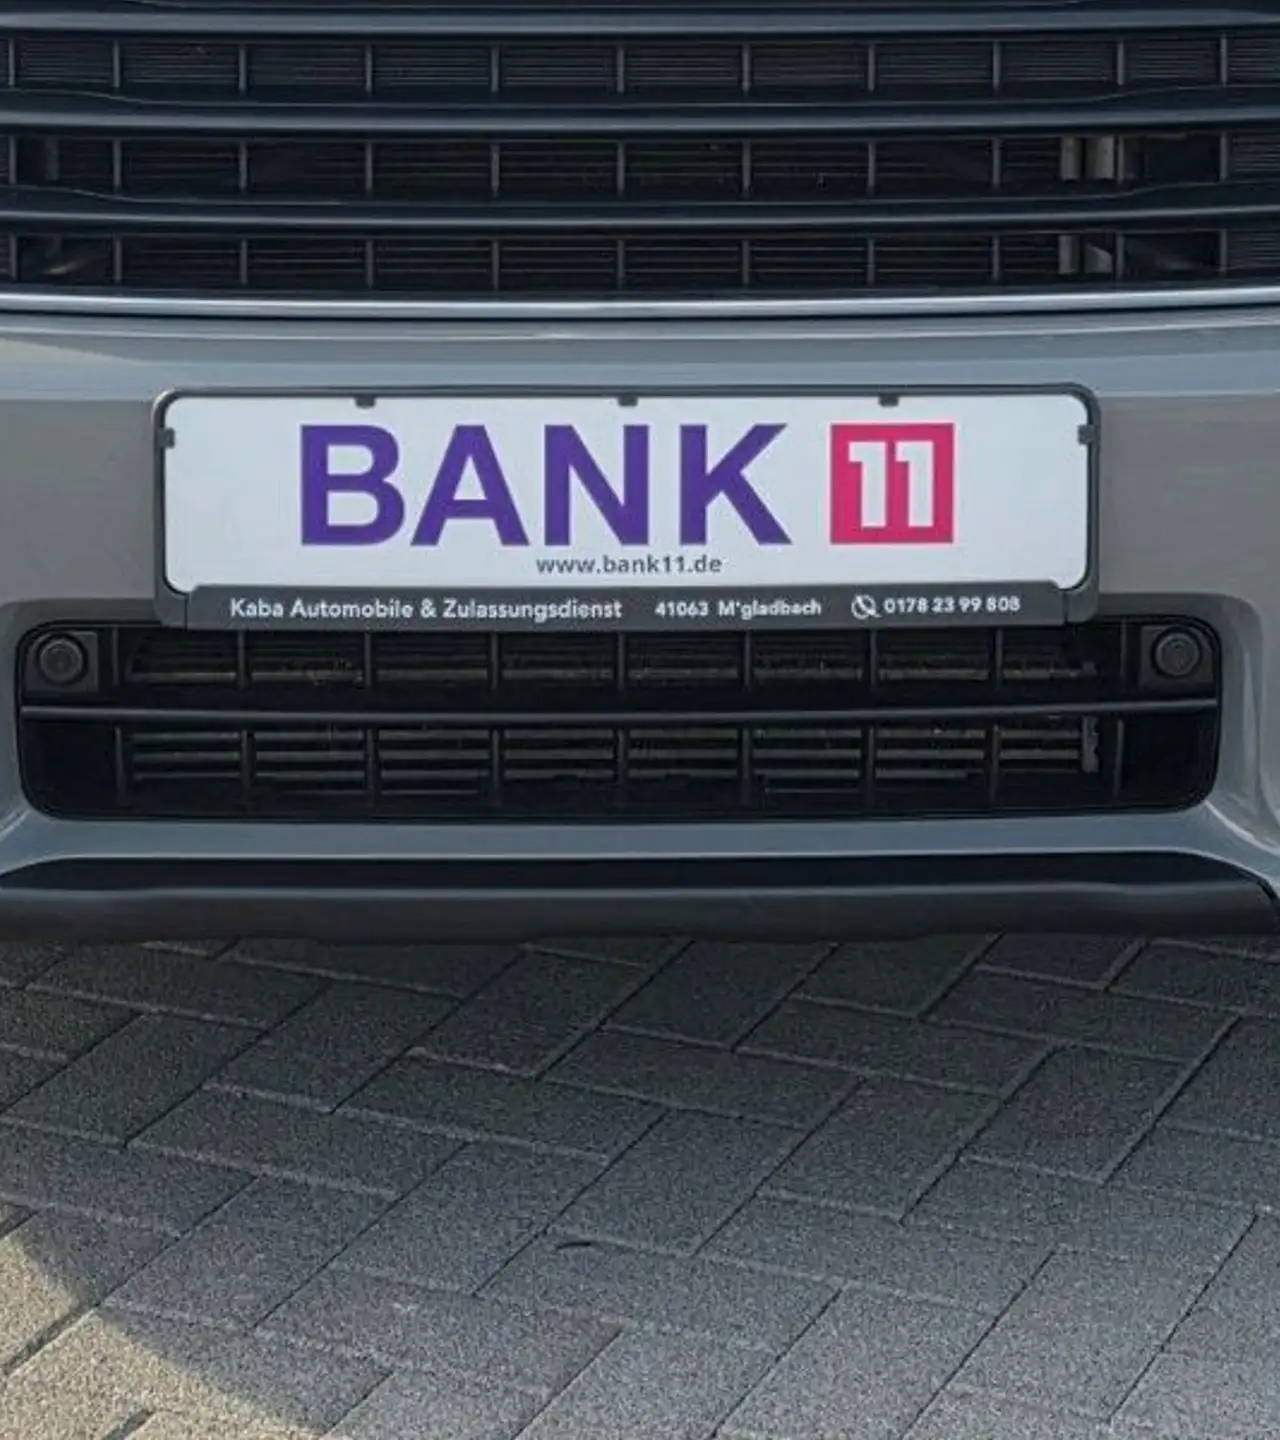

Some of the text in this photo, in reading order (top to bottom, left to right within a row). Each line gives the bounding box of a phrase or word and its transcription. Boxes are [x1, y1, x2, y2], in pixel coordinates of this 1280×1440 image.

[300, 424, 938, 546] BANK 11
[536, 554, 722, 575] www.bank11.de
[230, 598, 284, 618] Kaba
[290, 598, 413, 619] Automobile
[420, 598, 436, 618] &
[443, 598, 623, 623] Zulassungsdienst
[654, 601, 709, 617] 41063
[884, 597, 927, 614] 0178
[957, 596, 982, 612] 99
